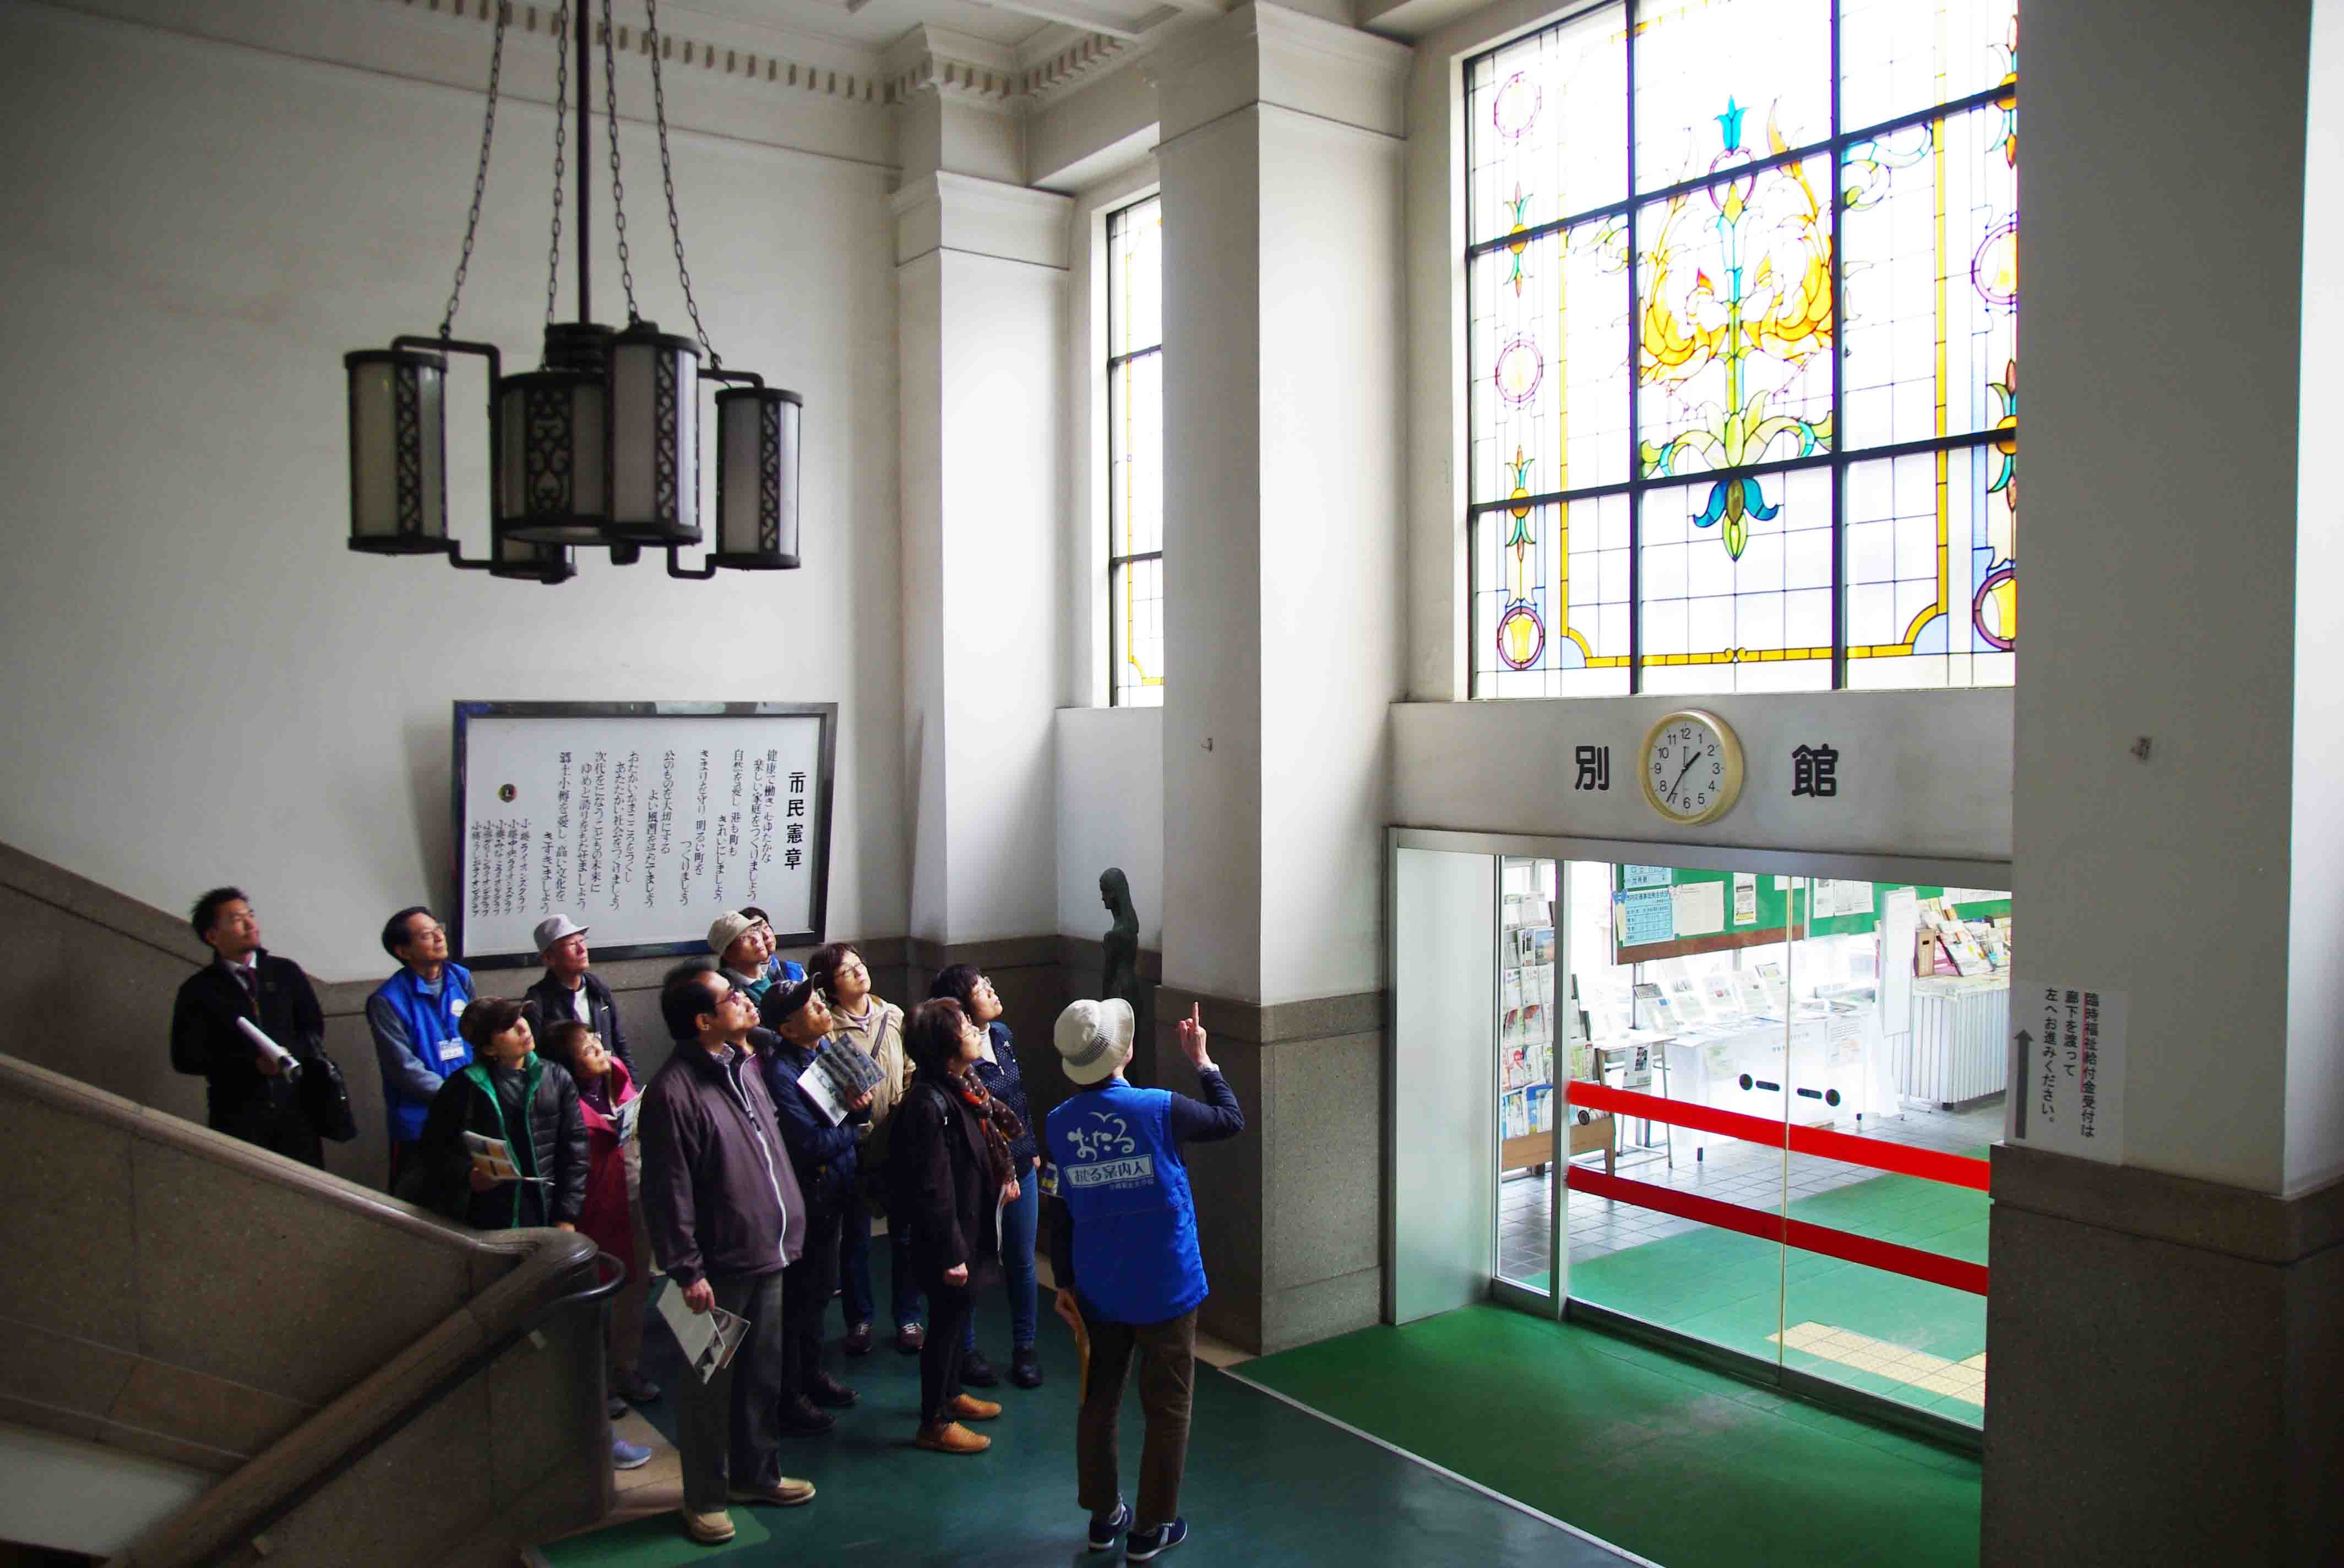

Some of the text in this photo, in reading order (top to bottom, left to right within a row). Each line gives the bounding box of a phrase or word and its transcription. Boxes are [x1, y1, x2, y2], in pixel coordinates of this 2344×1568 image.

[1668, 734, 1676, 744] 11
[1680, 728, 1690, 739] 12
[1698, 733, 1703, 743] 1
[1658, 747, 1669, 759] 10
[1707, 744, 1715, 756] 2
[1575, 743, 1839, 798] 別 館
[1655, 763, 1661, 774] 9
[1713, 763, 1720, 774] 3
[1660, 780, 1667, 792] 8
[1708, 781, 1715, 791] 4
[1671, 792, 1678, 804] 7
[1683, 797, 1691, 809] 6
[1698, 793, 1705, 804] 5
[785, 772, 806, 870] 市民憲章
